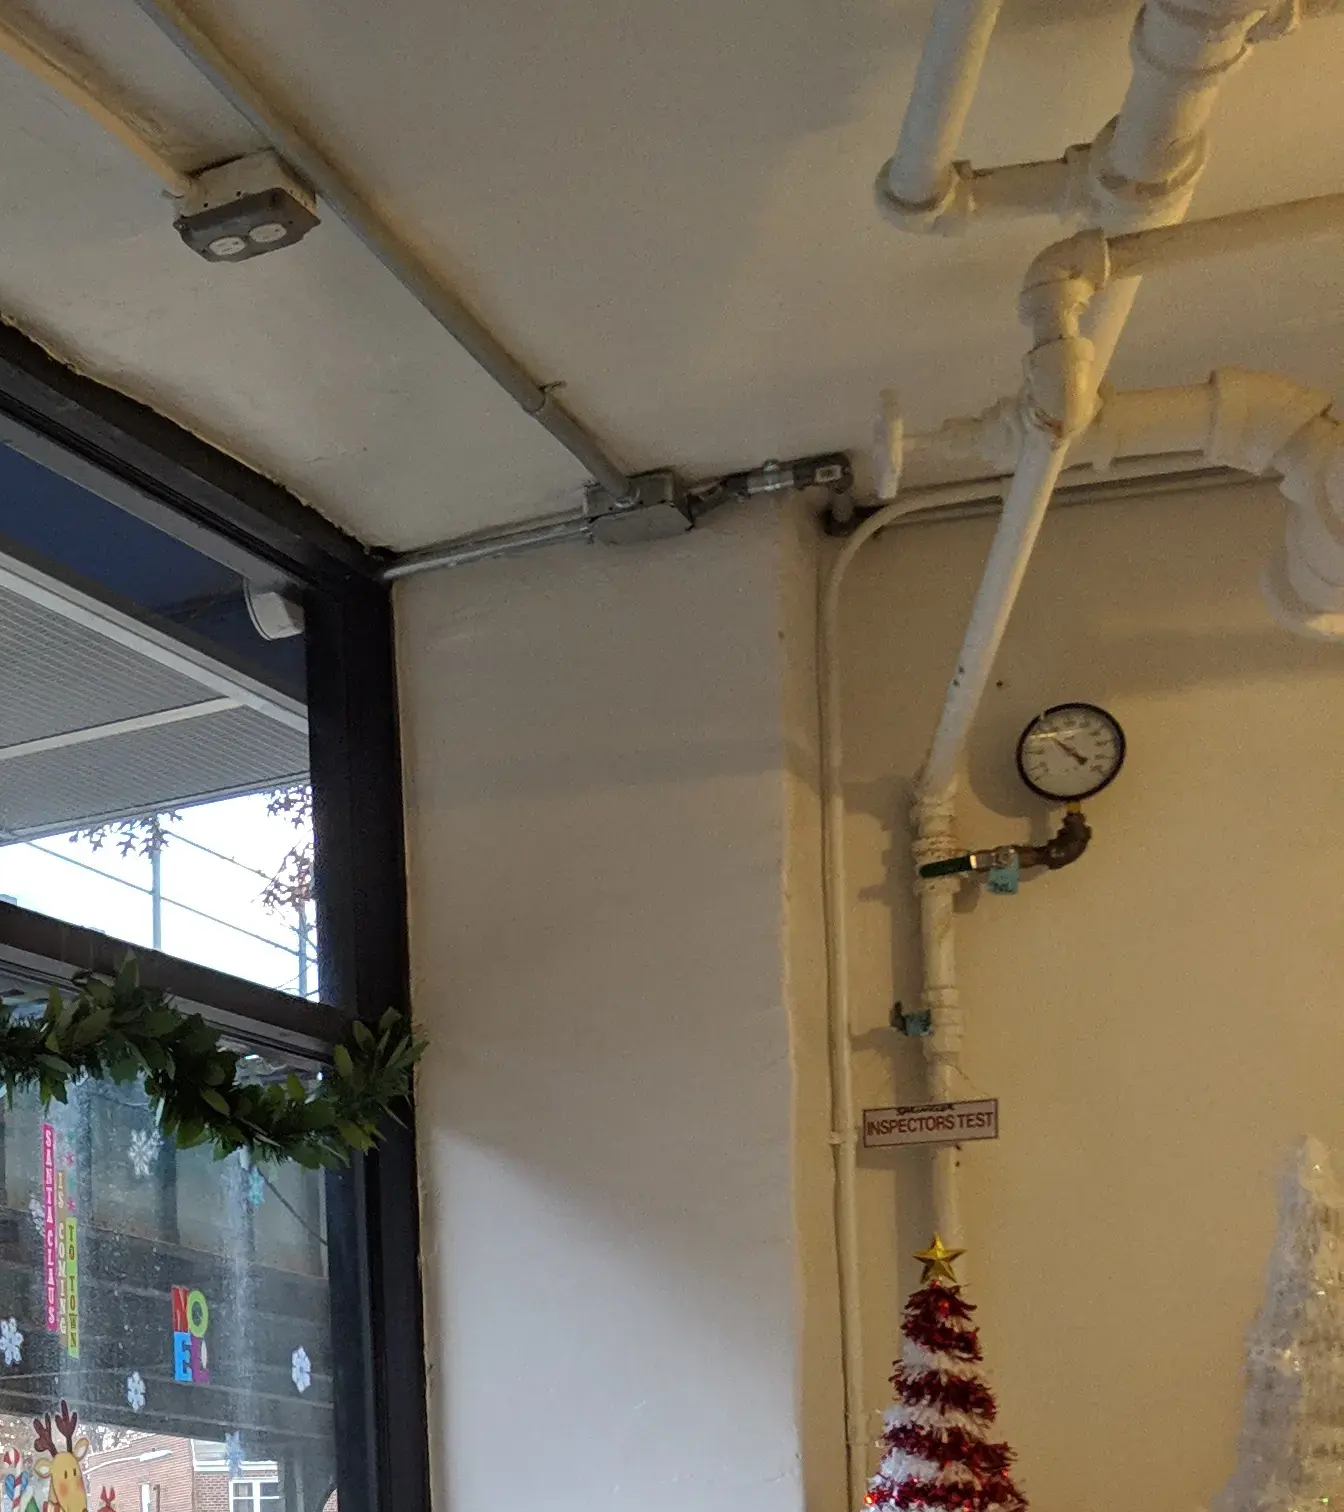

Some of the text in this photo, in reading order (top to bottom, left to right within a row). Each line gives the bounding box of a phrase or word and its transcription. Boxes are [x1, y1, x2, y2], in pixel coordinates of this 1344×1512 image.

[866, 1112, 994, 1136] INSPECTORS TEST
[44, 1129, 55, 1325] SANTA CLAUS
